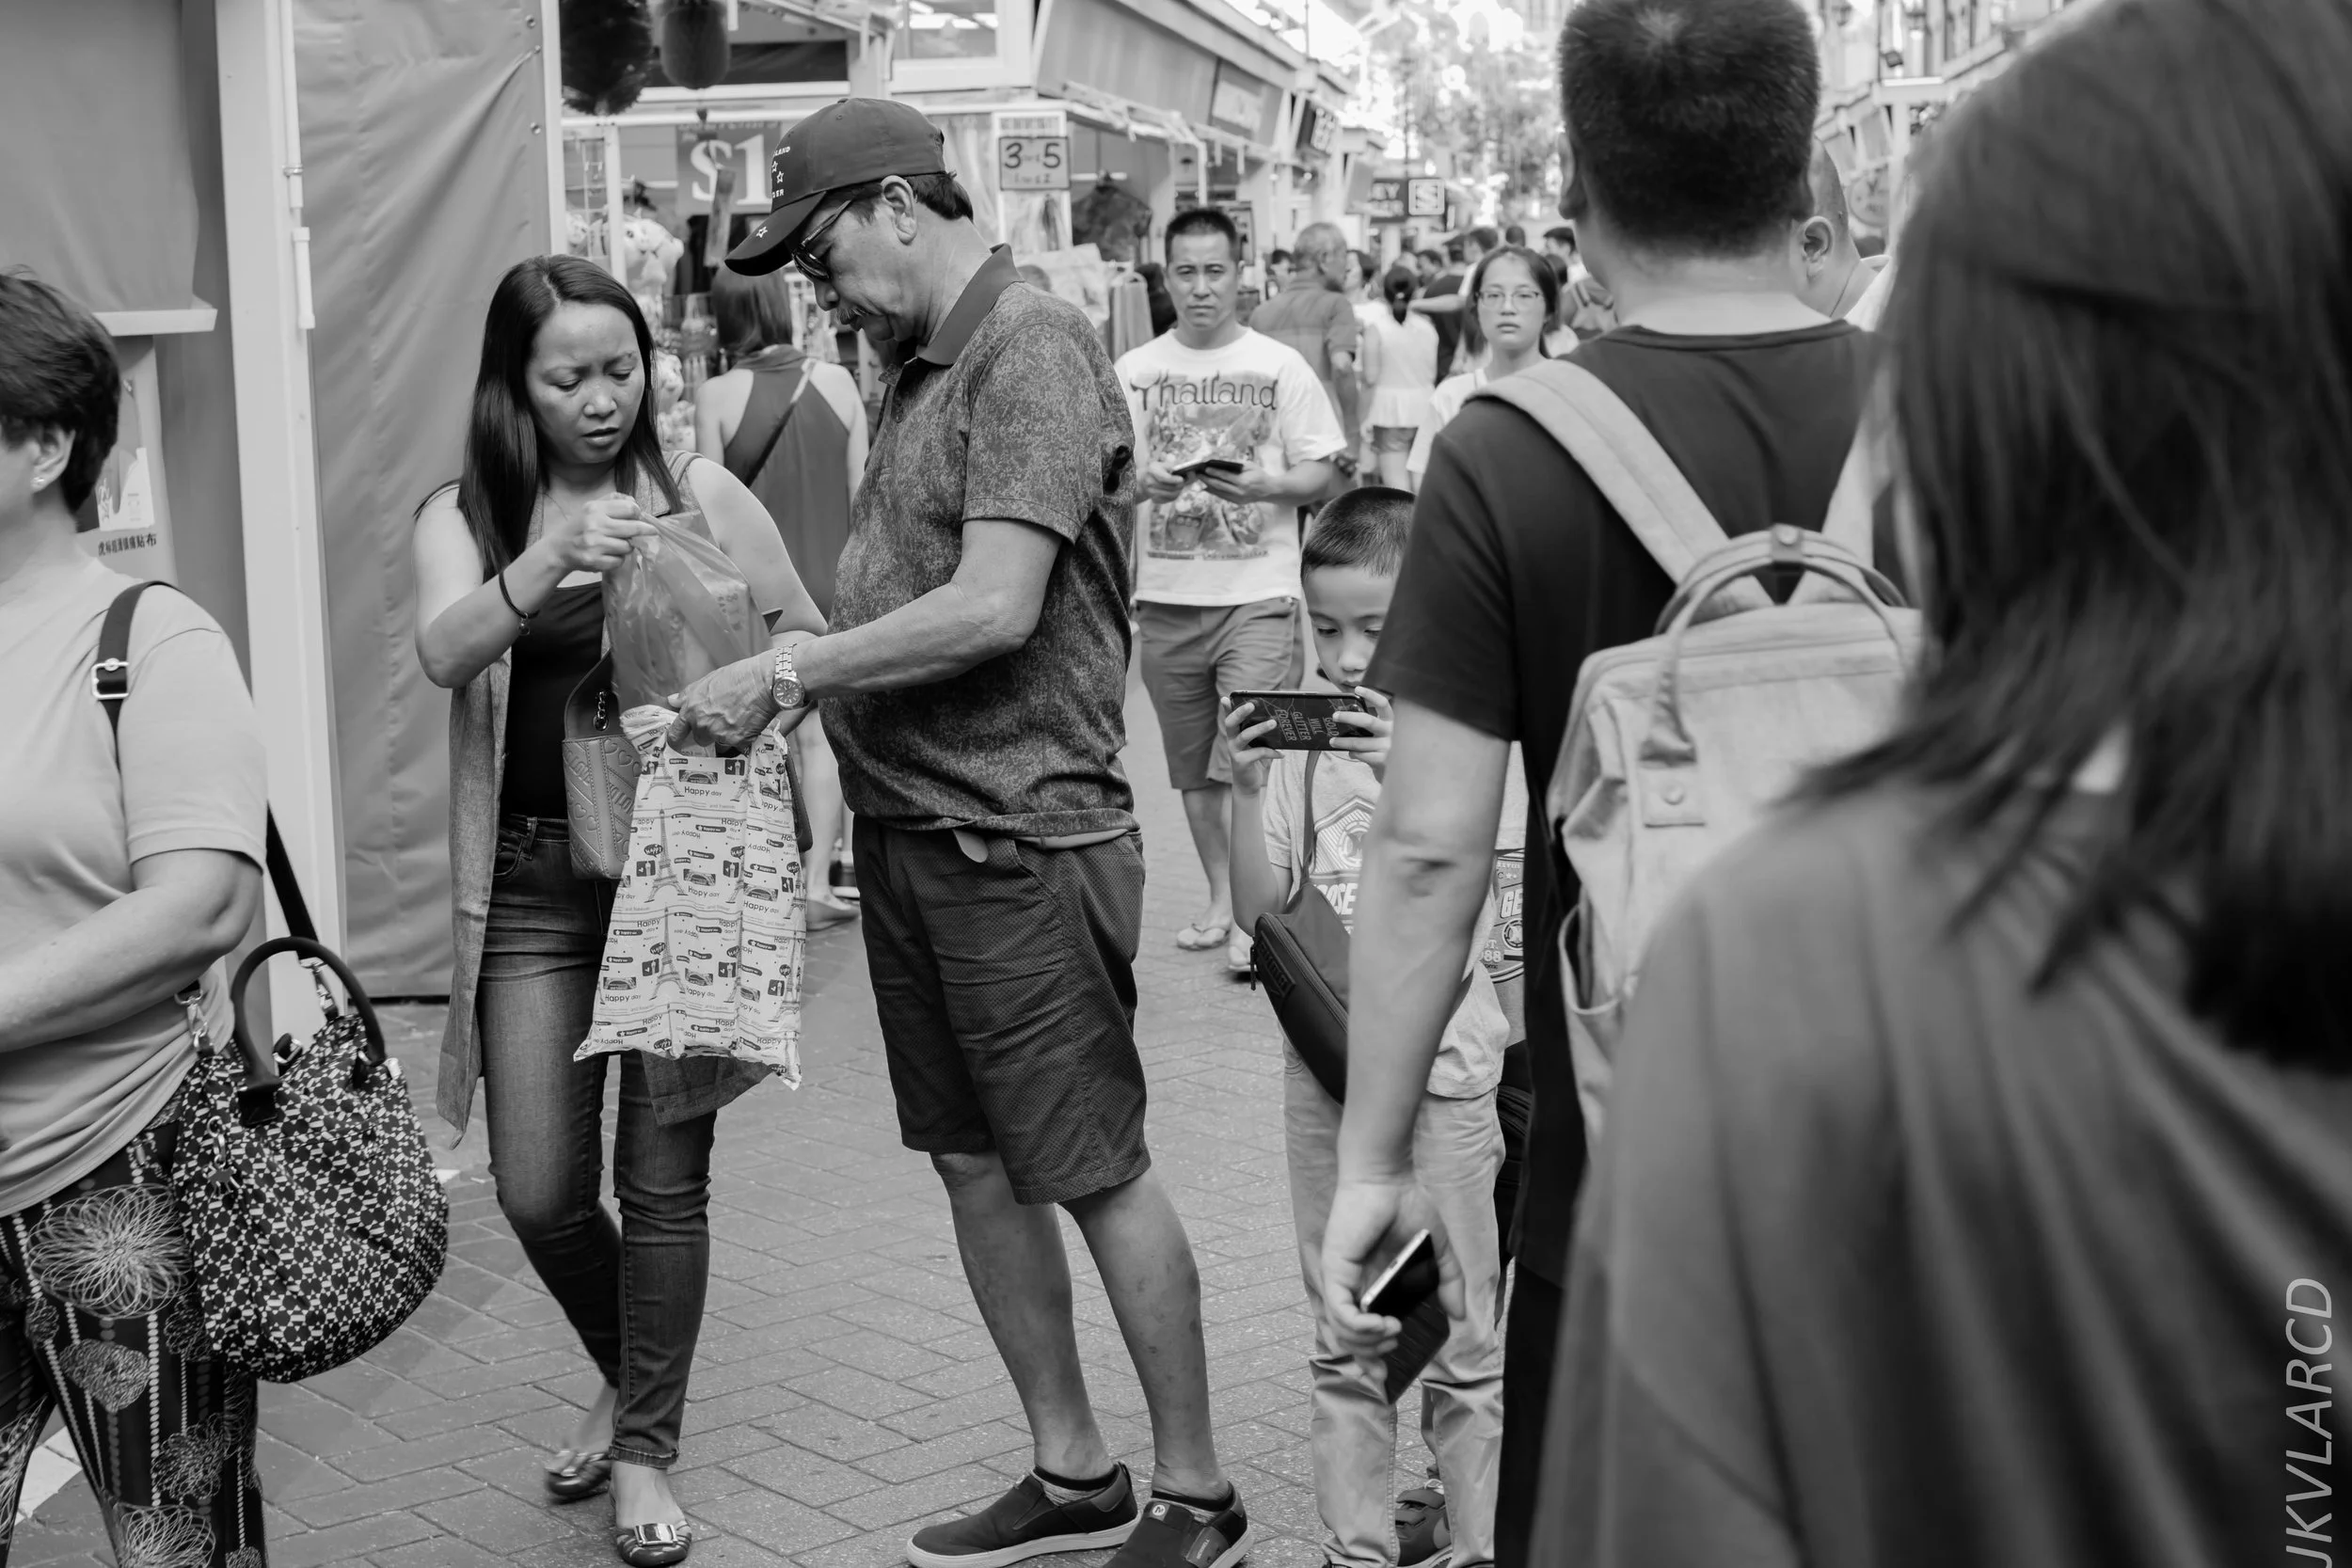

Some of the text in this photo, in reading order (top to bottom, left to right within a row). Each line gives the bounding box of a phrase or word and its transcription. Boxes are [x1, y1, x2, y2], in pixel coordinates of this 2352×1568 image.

[772, 146, 791, 157] LAND
[1130, 370, 1279, 411] Thailand
[1279, 709, 1297, 741] FOREVER
[1293, 711, 1312, 741] GLITTER
[684, 786, 710, 797] Happy
[743, 899, 770, 913] Happy
[605, 994, 629, 1003] Happy
